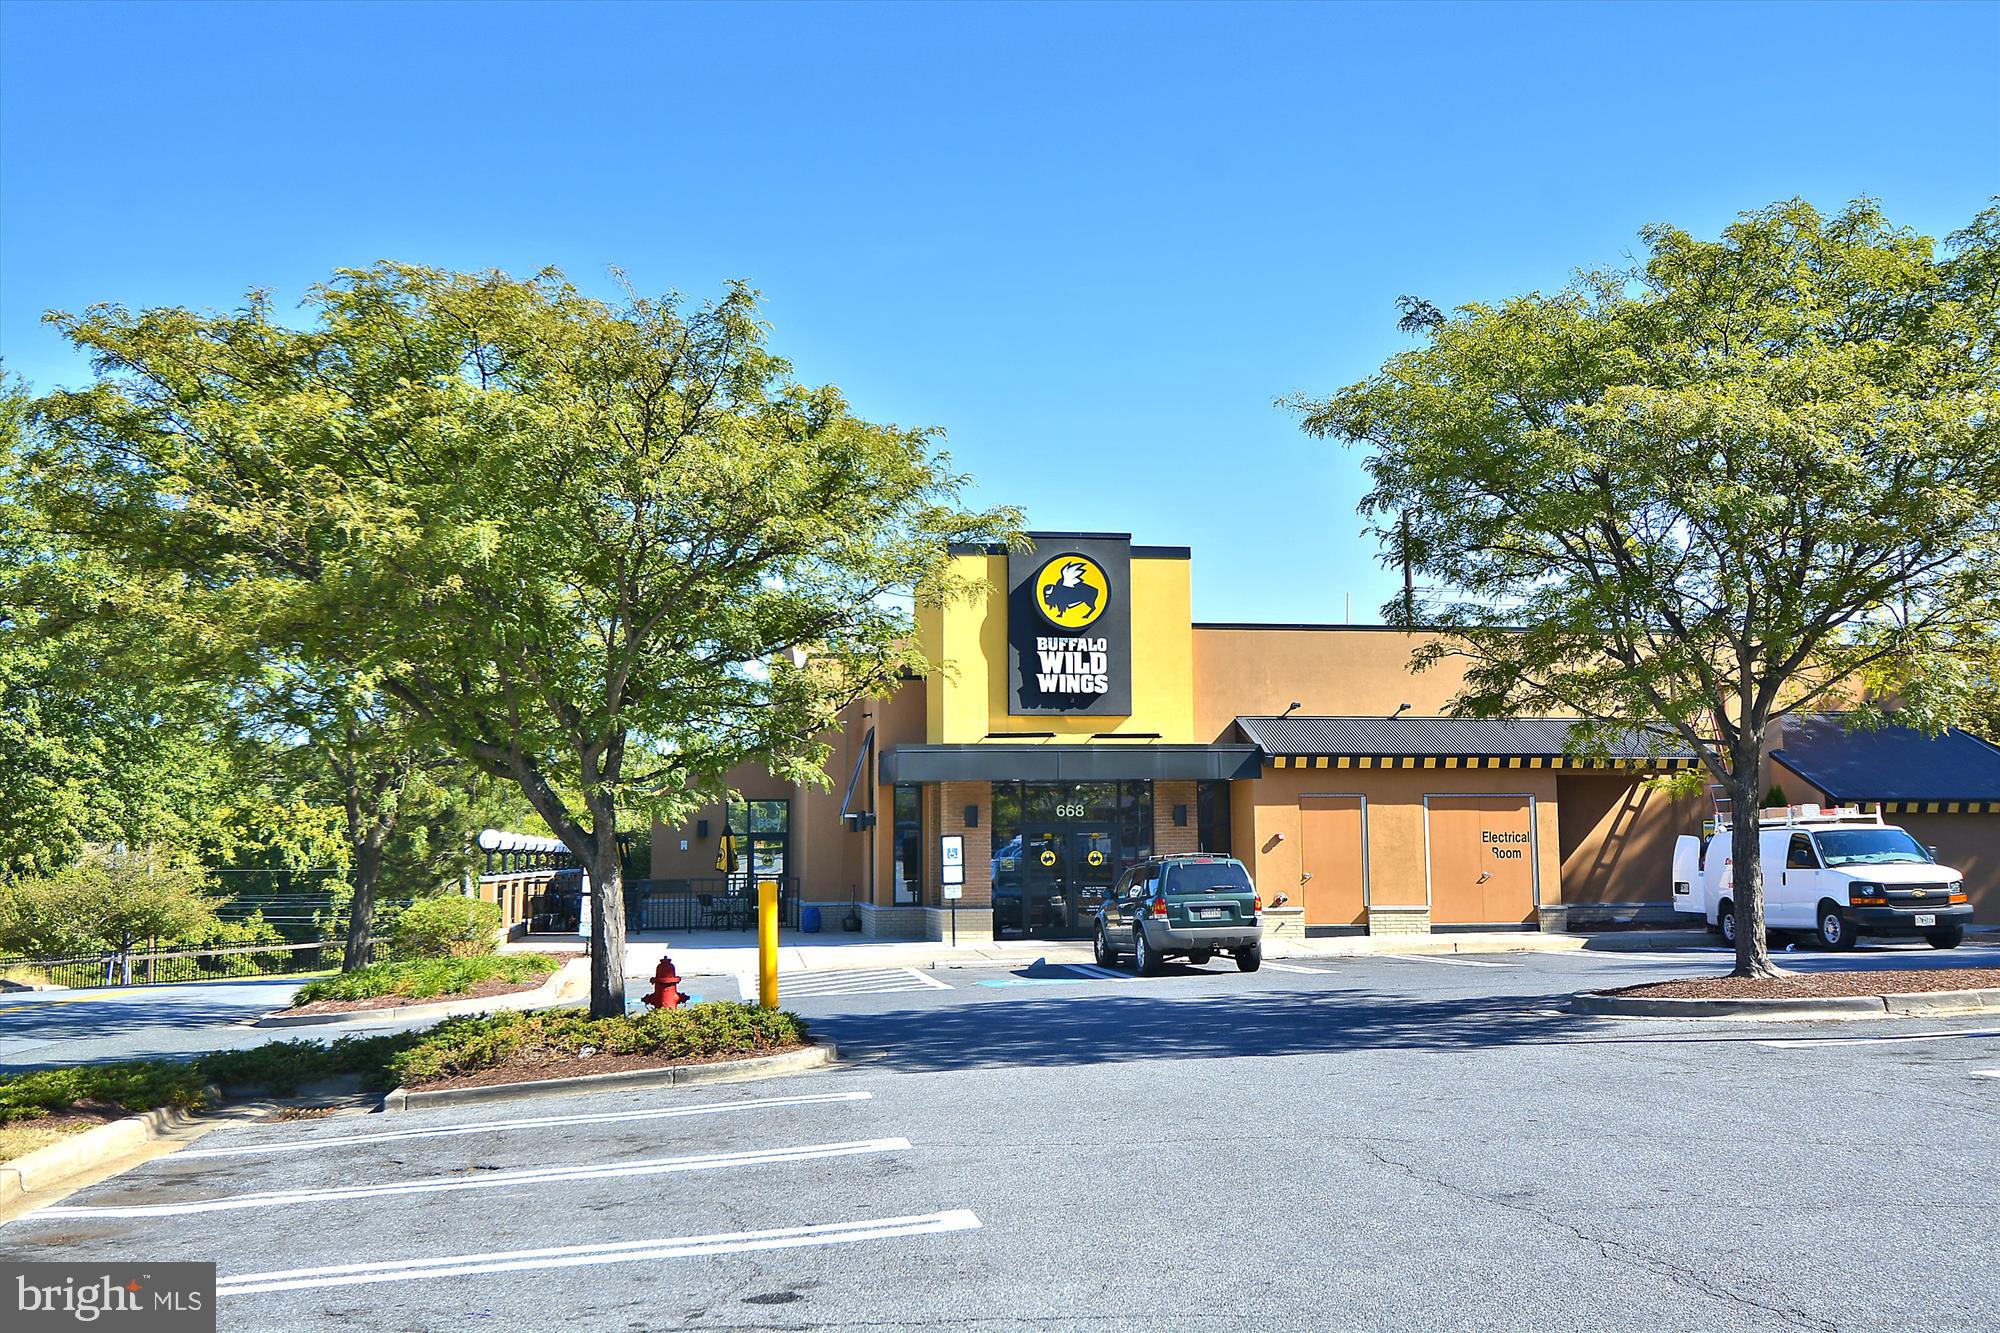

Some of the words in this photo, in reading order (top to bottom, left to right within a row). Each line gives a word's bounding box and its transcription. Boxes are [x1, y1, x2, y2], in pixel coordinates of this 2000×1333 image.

[1036, 637, 1107, 651] BUFFALO
[1037, 652, 1107, 674] WILD
[1036, 674, 1108, 694] WINGS
[1056, 805, 1084, 817] 668
[1482, 831, 1530, 843] Electrical
[1492, 847, 1522, 859] Room
